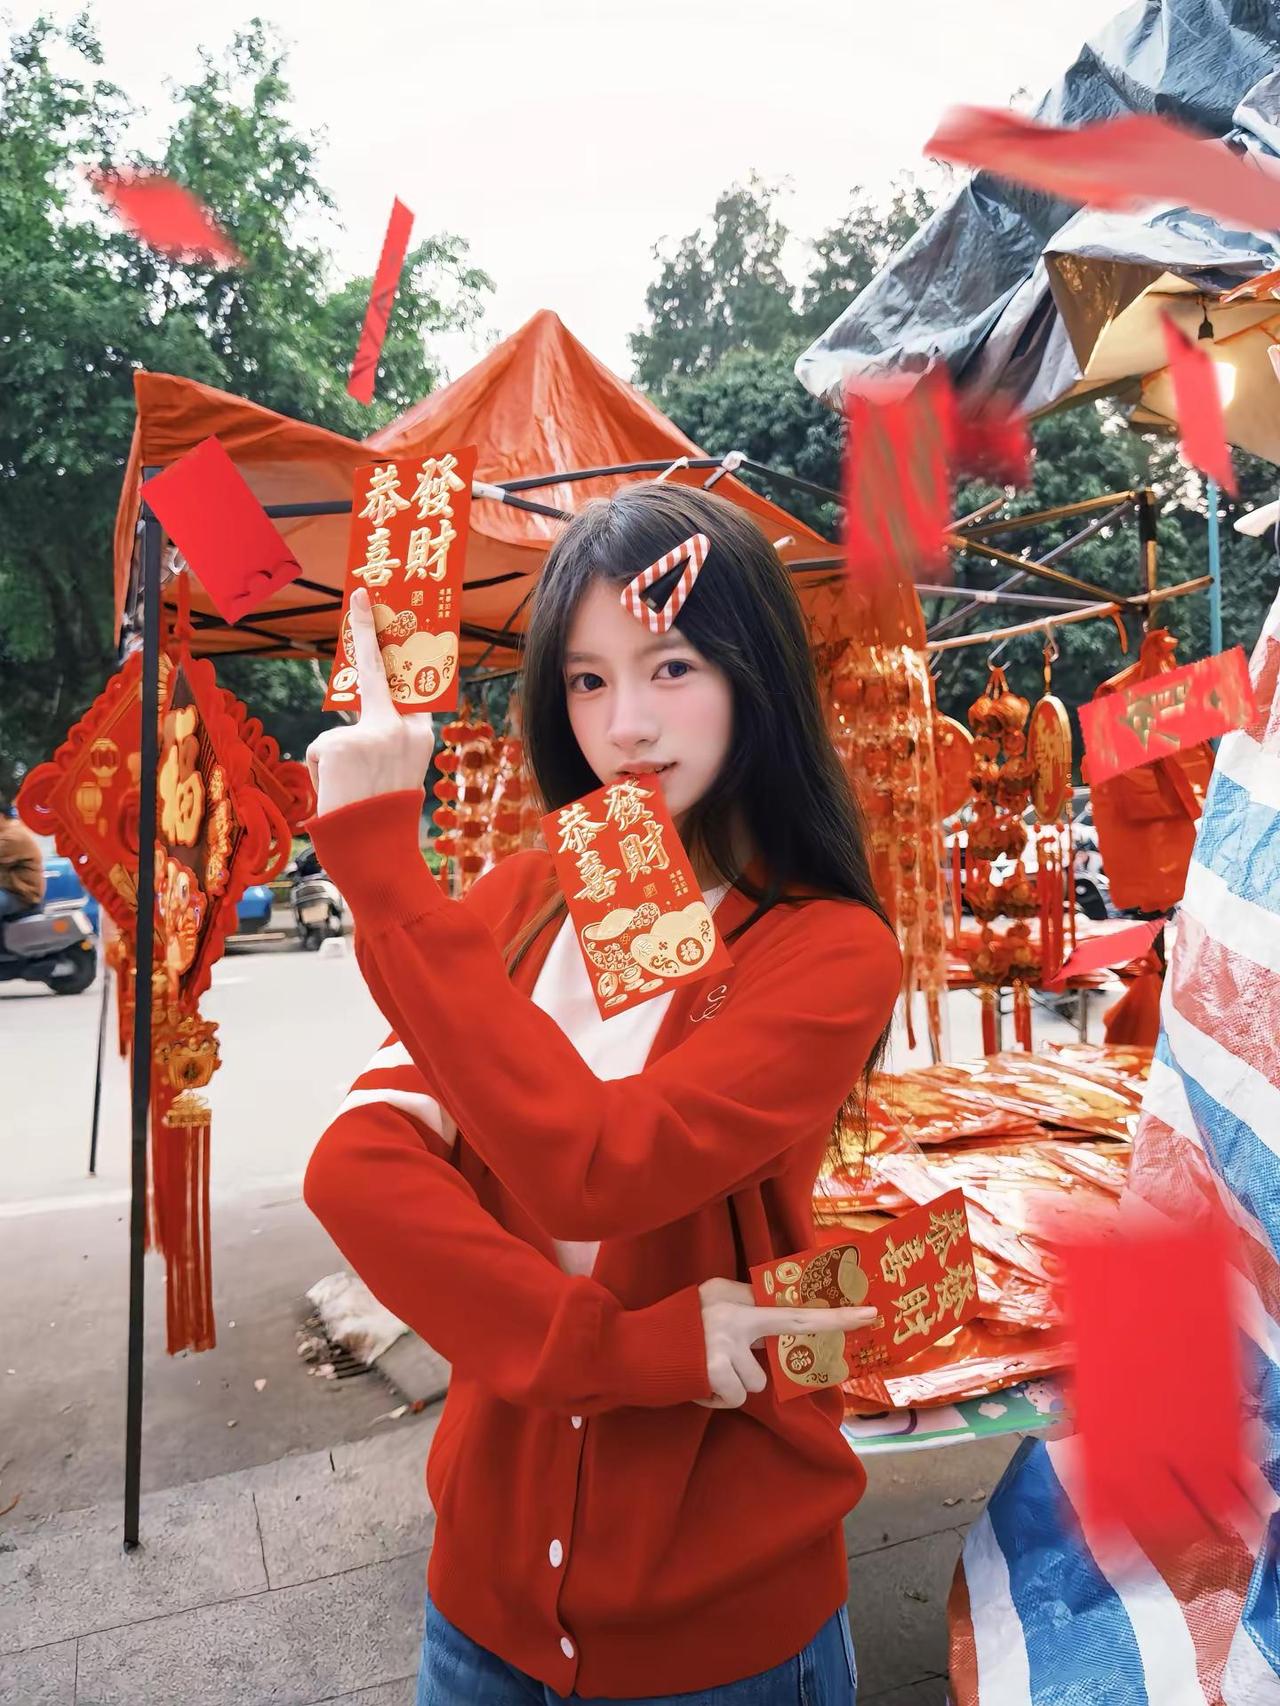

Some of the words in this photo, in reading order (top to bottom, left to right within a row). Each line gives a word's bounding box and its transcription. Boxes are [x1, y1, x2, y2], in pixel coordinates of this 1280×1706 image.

[352, 464, 411, 587] 恭喜
[404, 453, 466, 582] 發財
[558, 803, 622, 903] 恭喜
[880, 1208, 968, 1288] 恭喜
[891, 1262, 977, 1345] 發財
